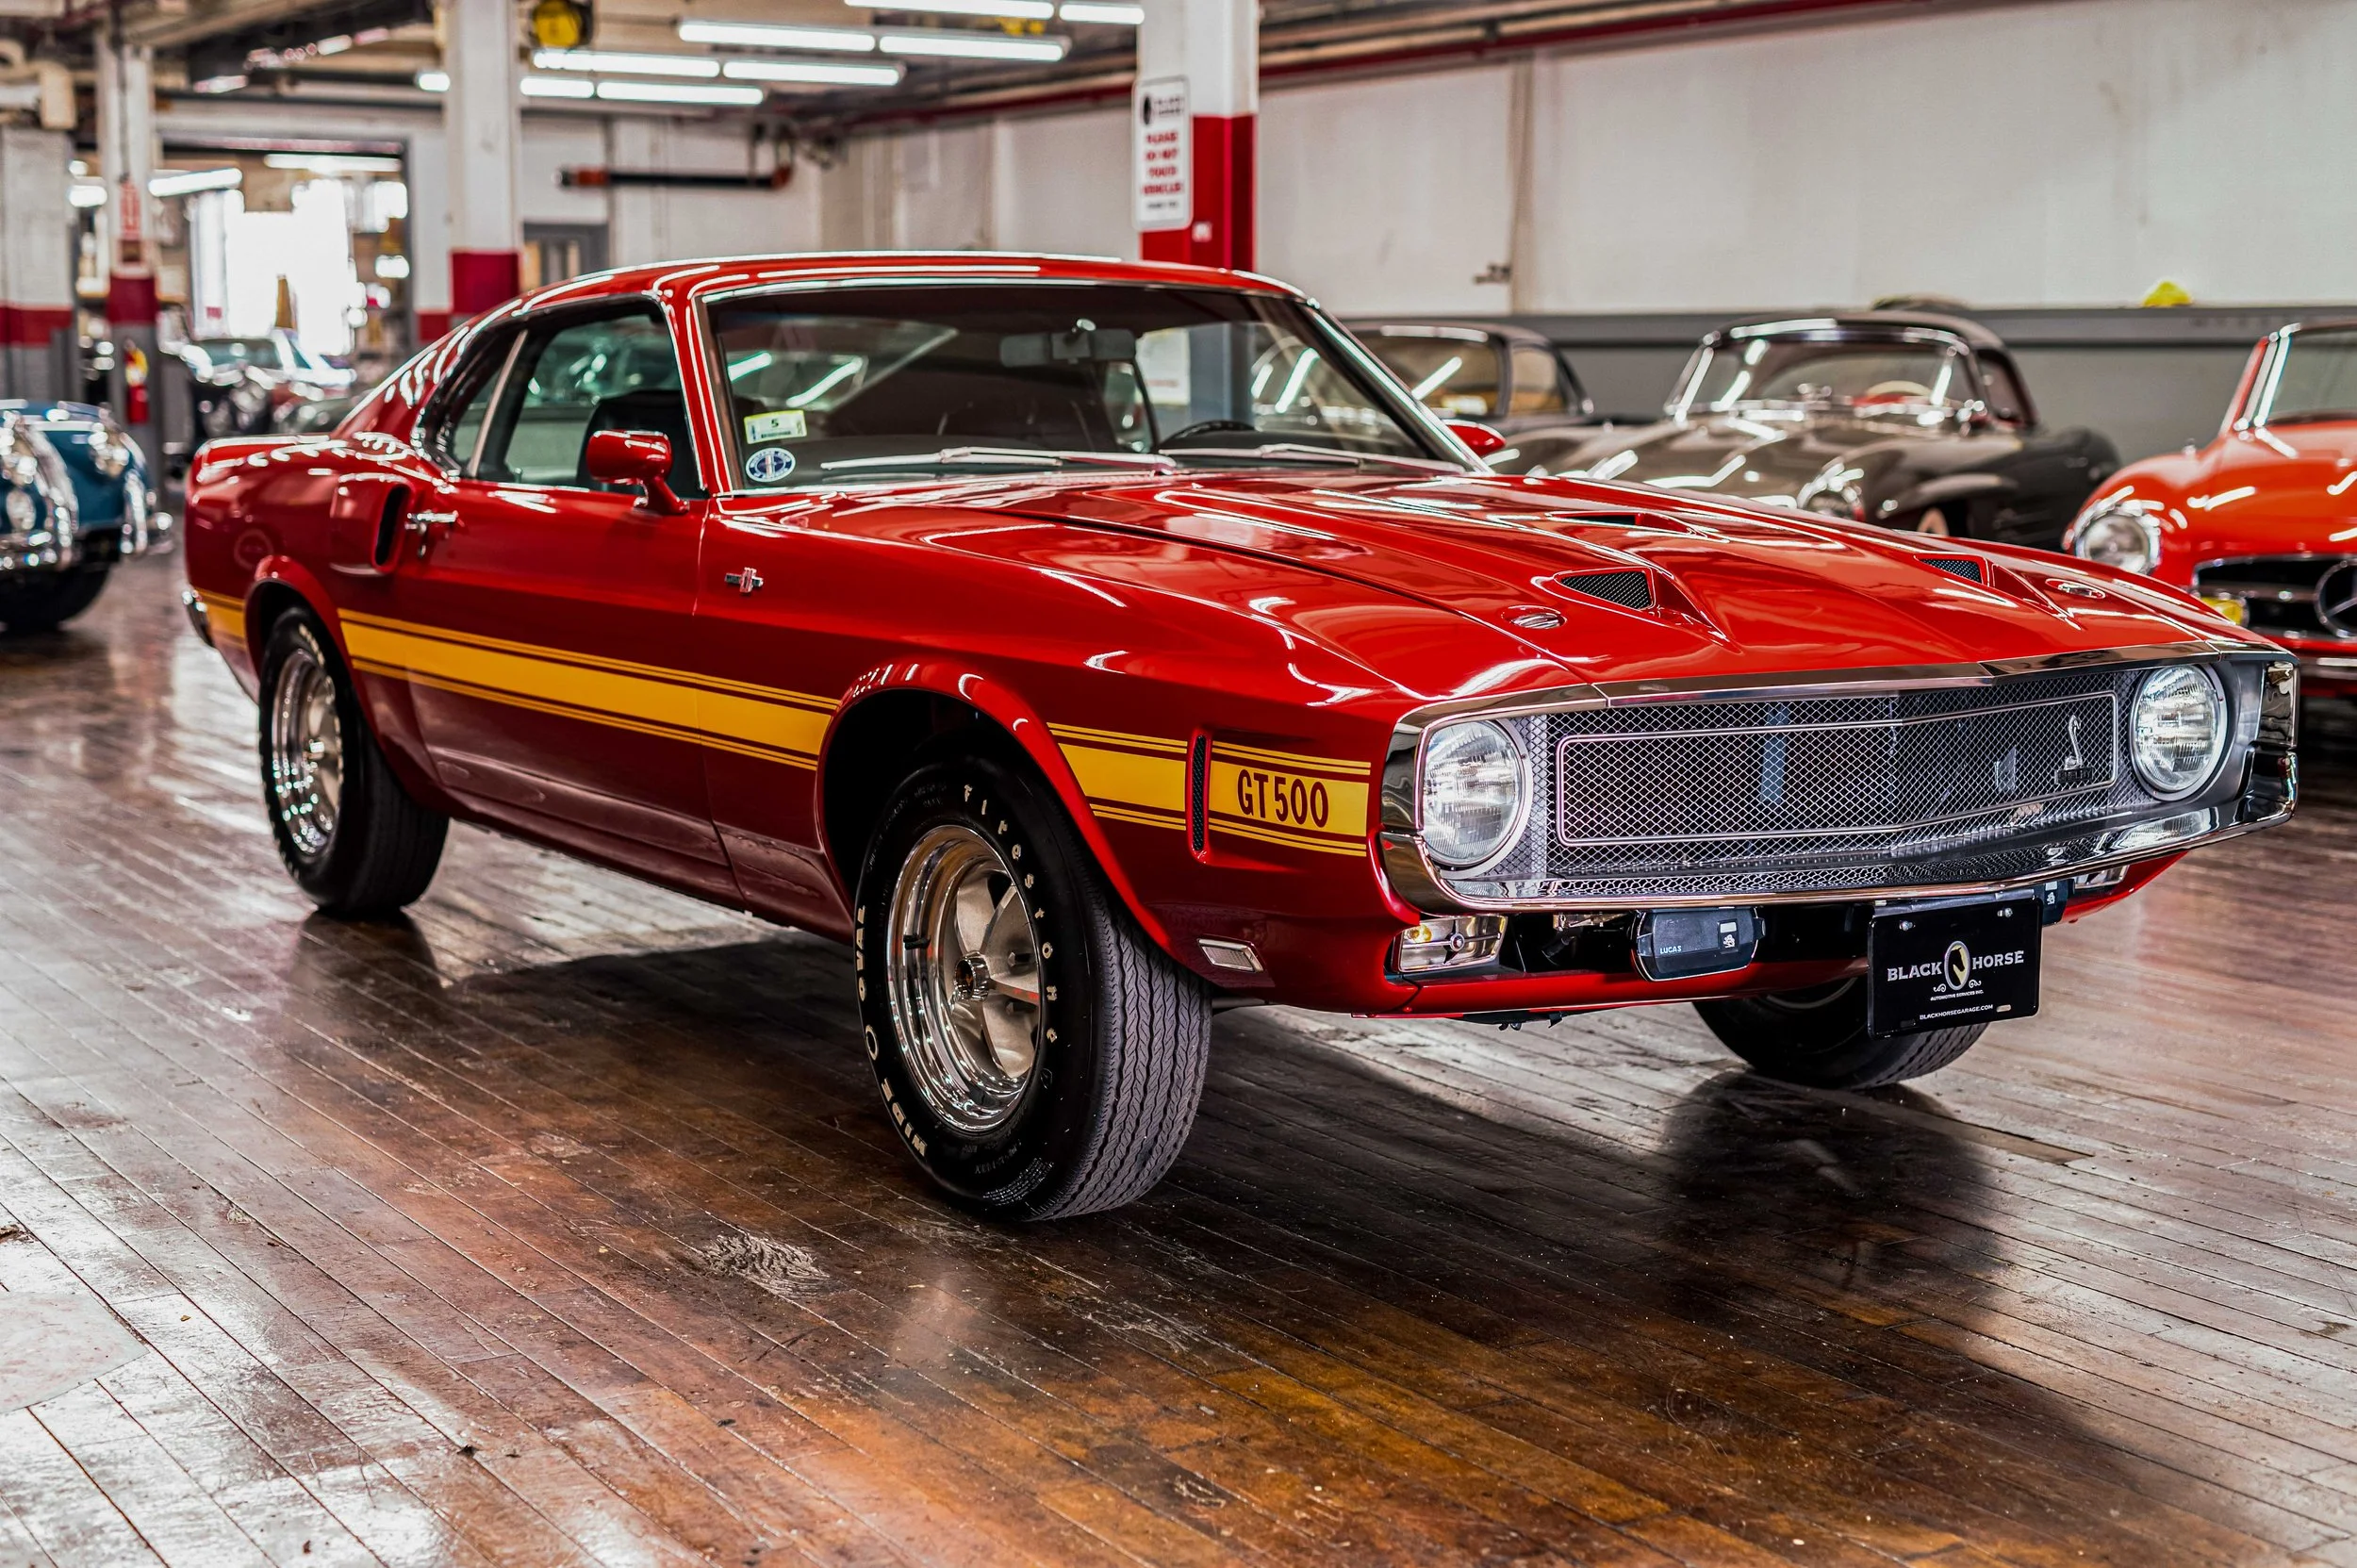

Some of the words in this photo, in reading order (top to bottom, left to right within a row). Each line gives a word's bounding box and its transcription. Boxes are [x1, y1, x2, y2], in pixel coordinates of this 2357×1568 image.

[1659, 945, 1682, 954] LUCAS
[1887, 962, 1942, 982] BLACK
[1971, 950, 2024, 970] HORSE
[1930, 993, 1956, 1001] AUTOMOTIVE
[1919, 1004, 1994, 1020] BLACKHORSEGARAGE.COM
